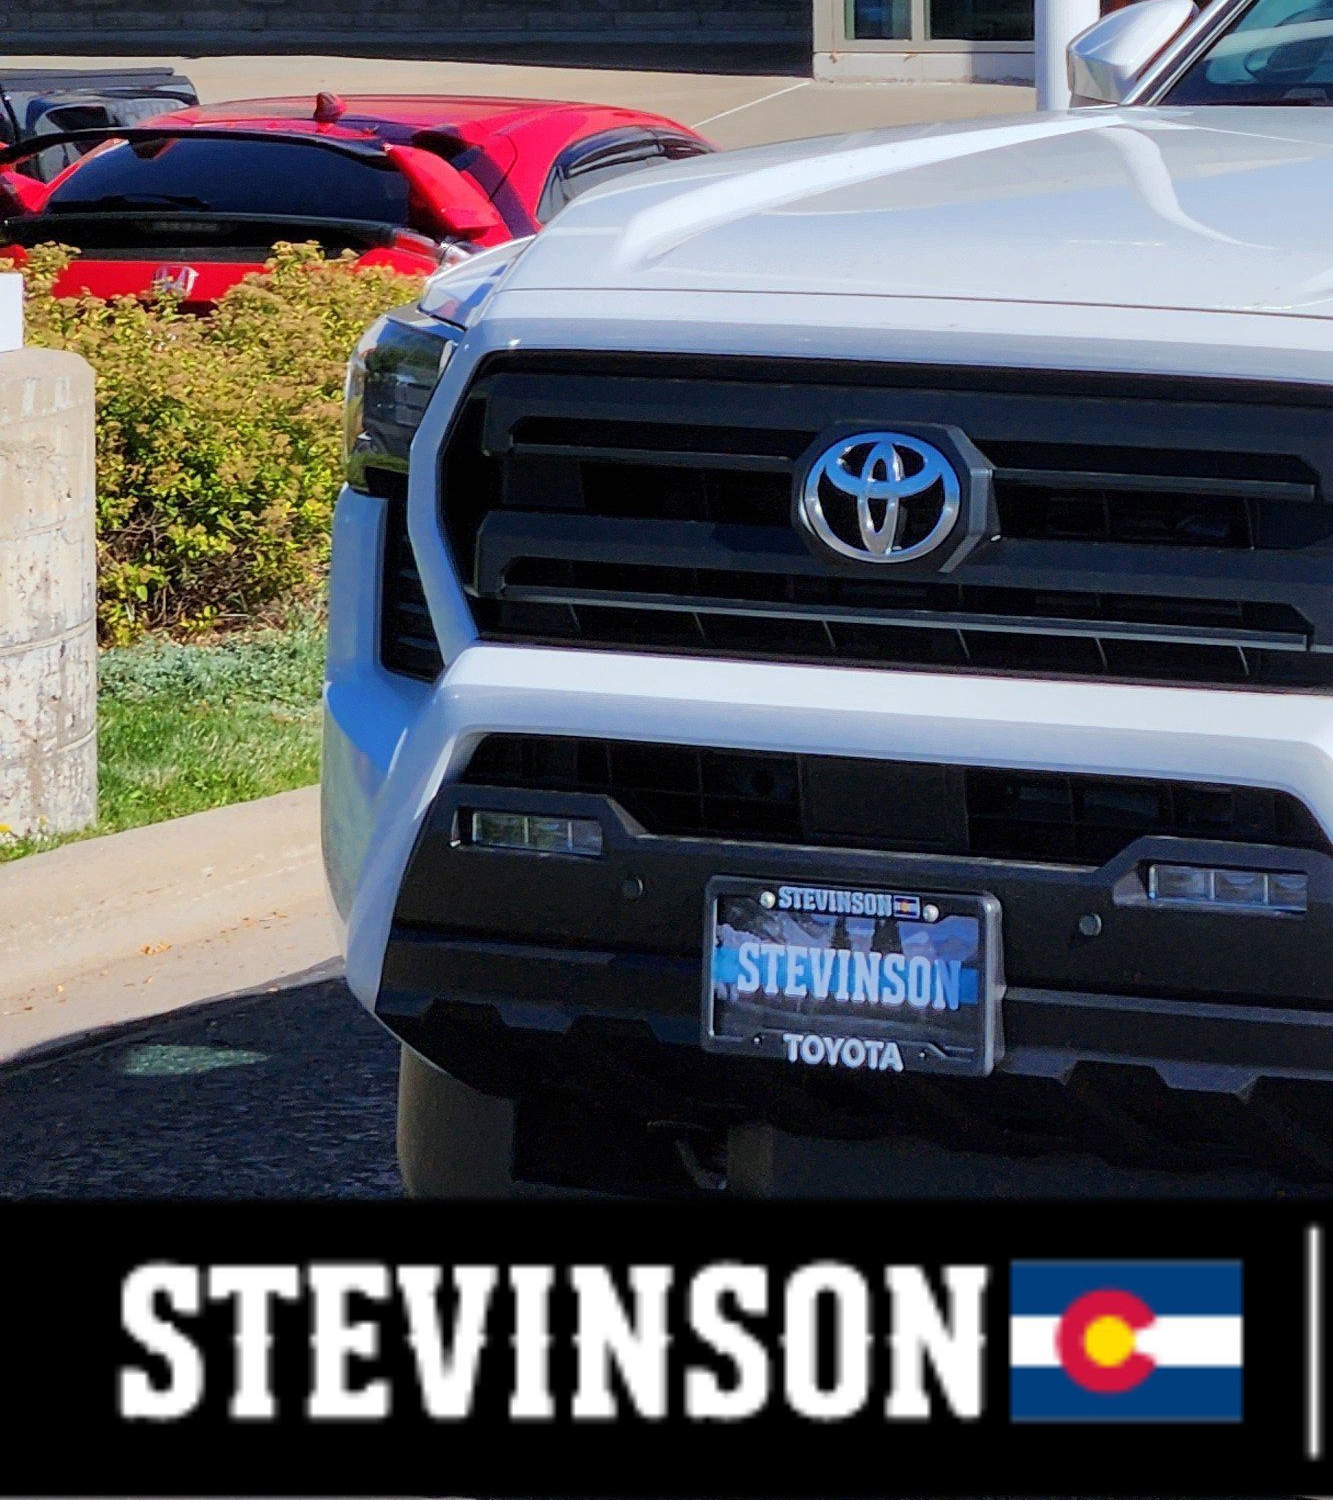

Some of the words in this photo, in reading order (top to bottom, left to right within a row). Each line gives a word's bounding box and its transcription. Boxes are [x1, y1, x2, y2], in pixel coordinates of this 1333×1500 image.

[778, 885, 893, 919] STEVINSON
[736, 940, 963, 1012] STEVINSON
[782, 1032, 904, 1073] TOYOTA
